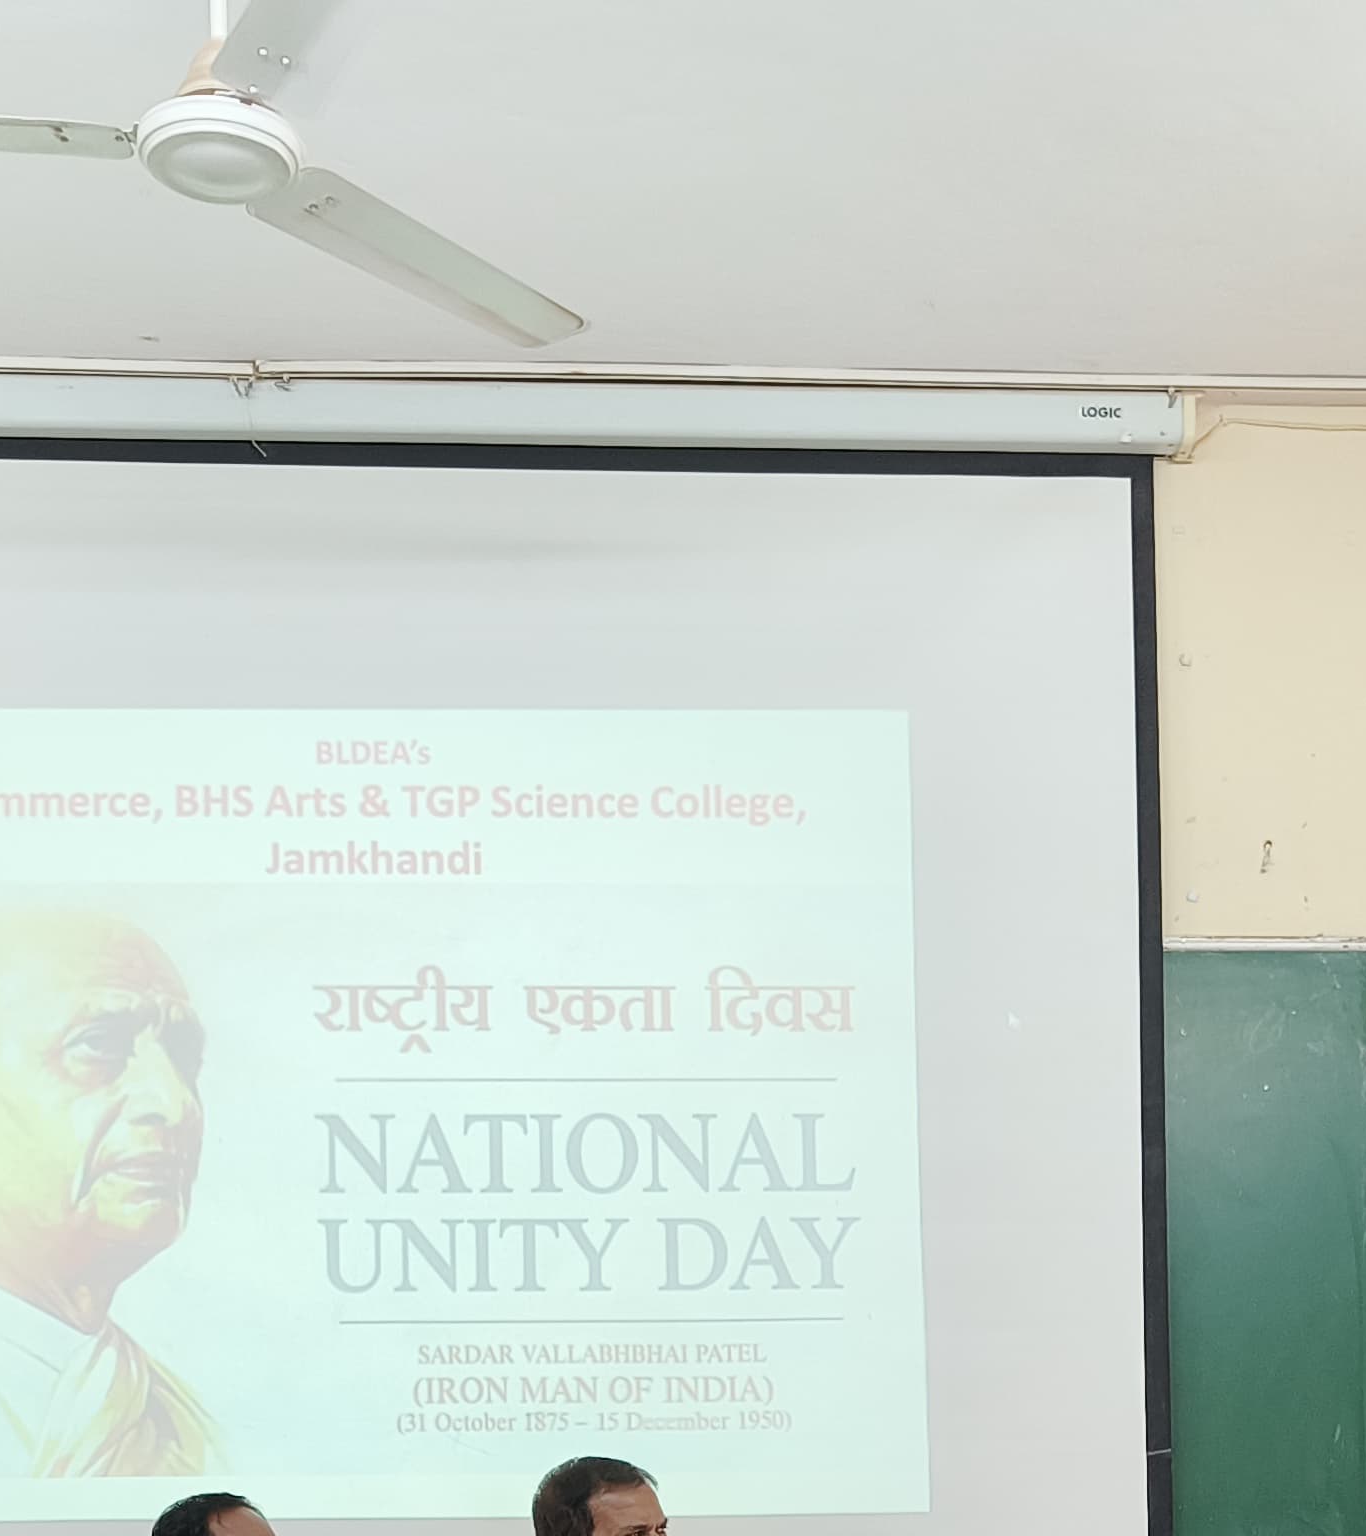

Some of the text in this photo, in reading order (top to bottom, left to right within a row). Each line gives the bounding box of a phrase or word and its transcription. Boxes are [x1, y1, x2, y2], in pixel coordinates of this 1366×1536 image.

[1081, 405, 1123, 419] LOGIC
[316, 739, 432, 767] BLDEA's
[173, 784, 255, 821] BHS
[264, 784, 347, 819] Arts
[358, 785, 391, 819] &
[402, 785, 481, 819] TGP
[490, 783, 640, 819] Science
[650, 784, 807, 827] College,
[264, 841, 484, 877] Jamkhandi
[311, 965, 856, 1054] राष्ट्रीय एकता दिवस
[313, 1111, 856, 1195] NATIONAL
[317, 1215, 862, 1294] UNITY DAY
[417, 1342, 767, 1366] SARDAR VALLABHBHAI PATEL
[412, 1375, 775, 1409] (IRON MAN OF INDIA)
[396, 1409, 793, 1435] (31 October 1875 15 December 1950)
